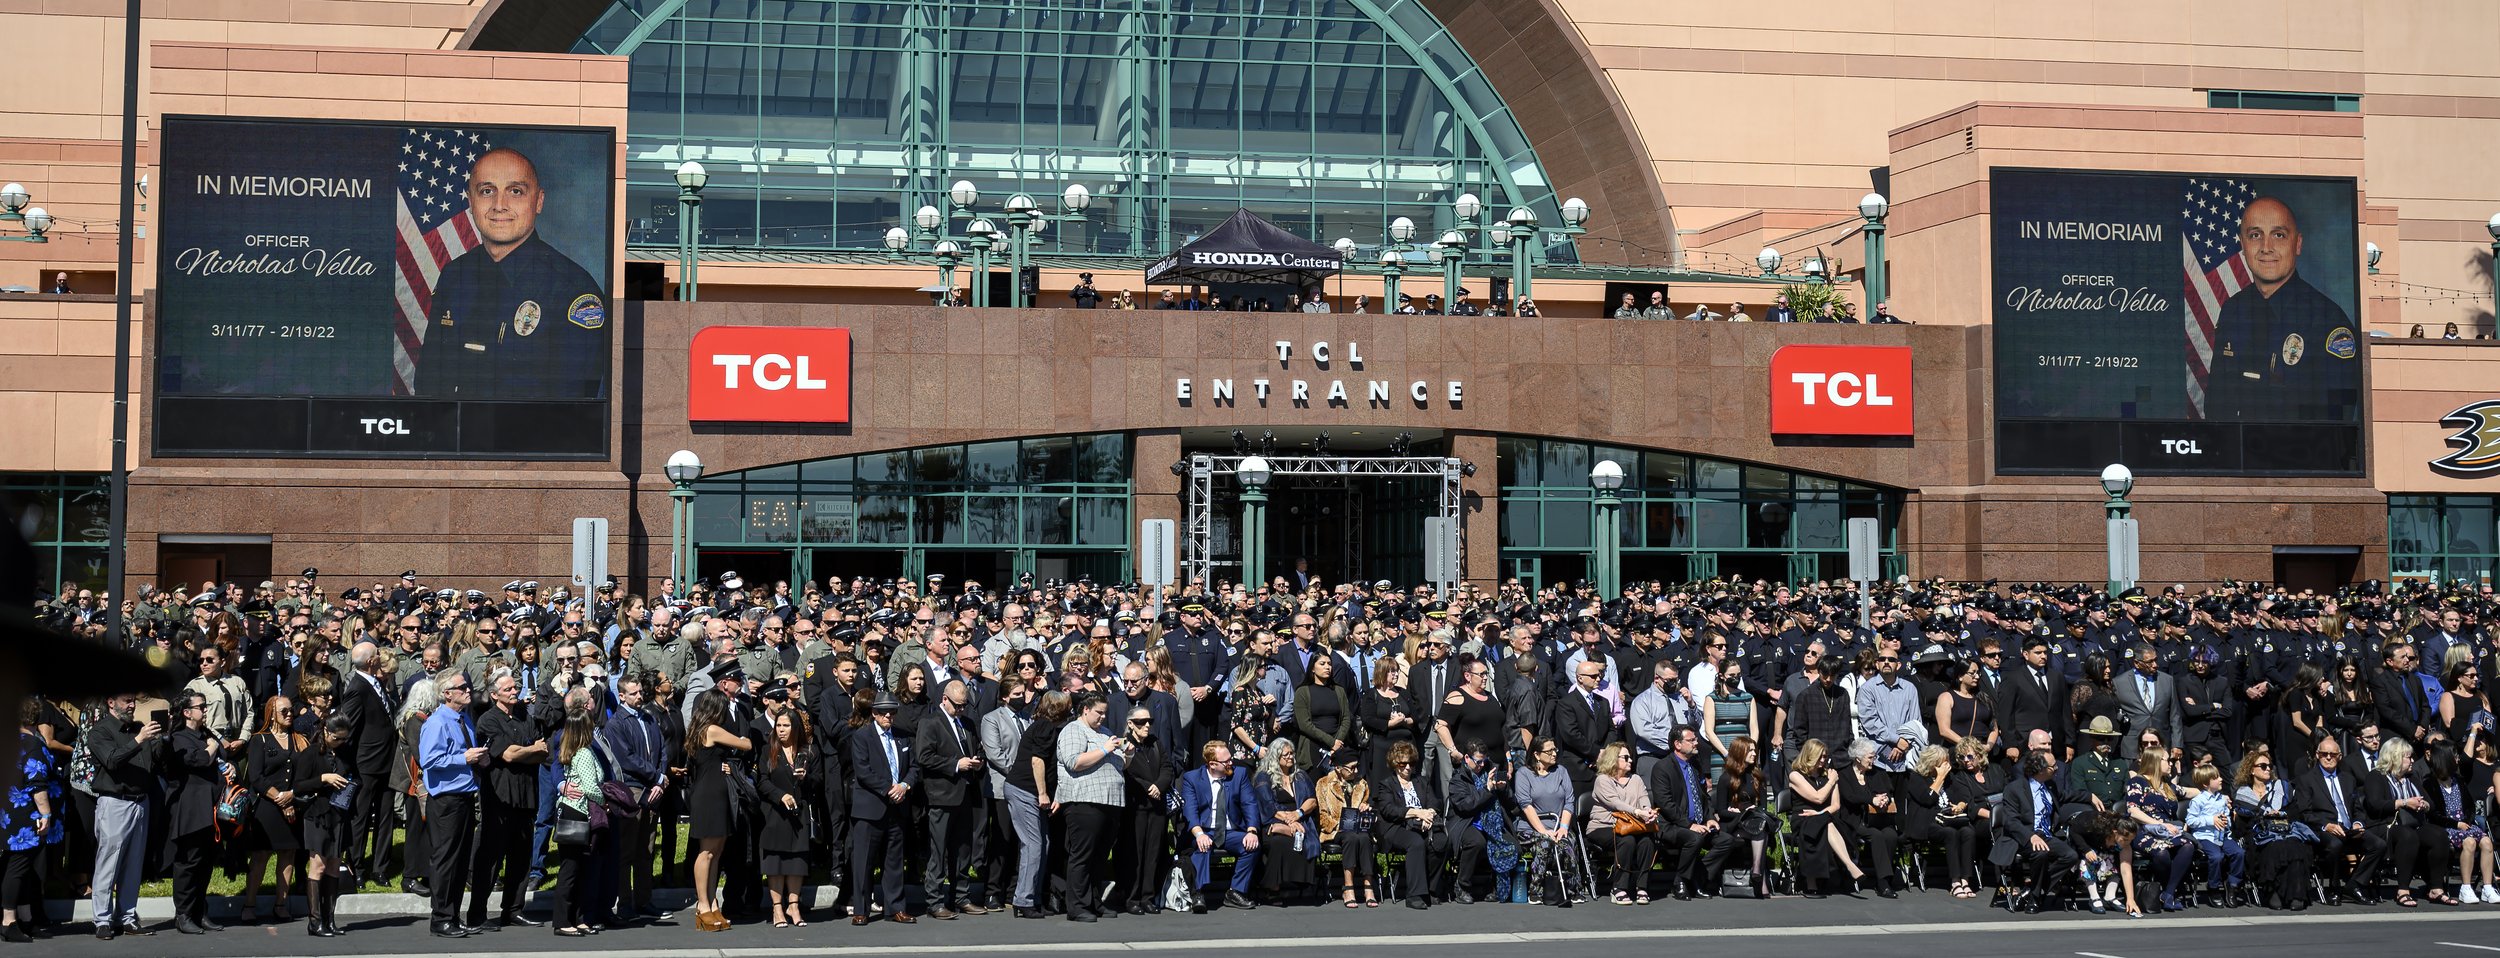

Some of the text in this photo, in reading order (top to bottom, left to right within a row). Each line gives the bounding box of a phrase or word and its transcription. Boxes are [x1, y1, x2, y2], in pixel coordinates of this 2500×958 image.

[197, 174, 371, 199] IN MEMORIAM
[244, 234, 310, 248] OFFICER
[2020, 220, 2162, 242] IN MEMORIAM
[175, 247, 377, 278] Nicholas Vella
[1192, 252, 1281, 266] HONDA
[2061, 274, 2115, 287] OFFICER
[2006, 285, 2170, 313] Nicholas Vella
[211, 324, 266, 337] 3/11/77
[280, 325, 335, 338] 2/19/22
[1275, 340, 1363, 363] TCL
[2038, 355, 2082, 367] 3/11/77
[2094, 356, 2139, 368] 2/19/22
[713, 354, 827, 391] TCL
[1176, 378, 1463, 401] ENTRANCE
[1791, 371, 1893, 407] TCL
[360, 417, 411, 435] TCL
[2161, 438, 2203, 455] TCL
